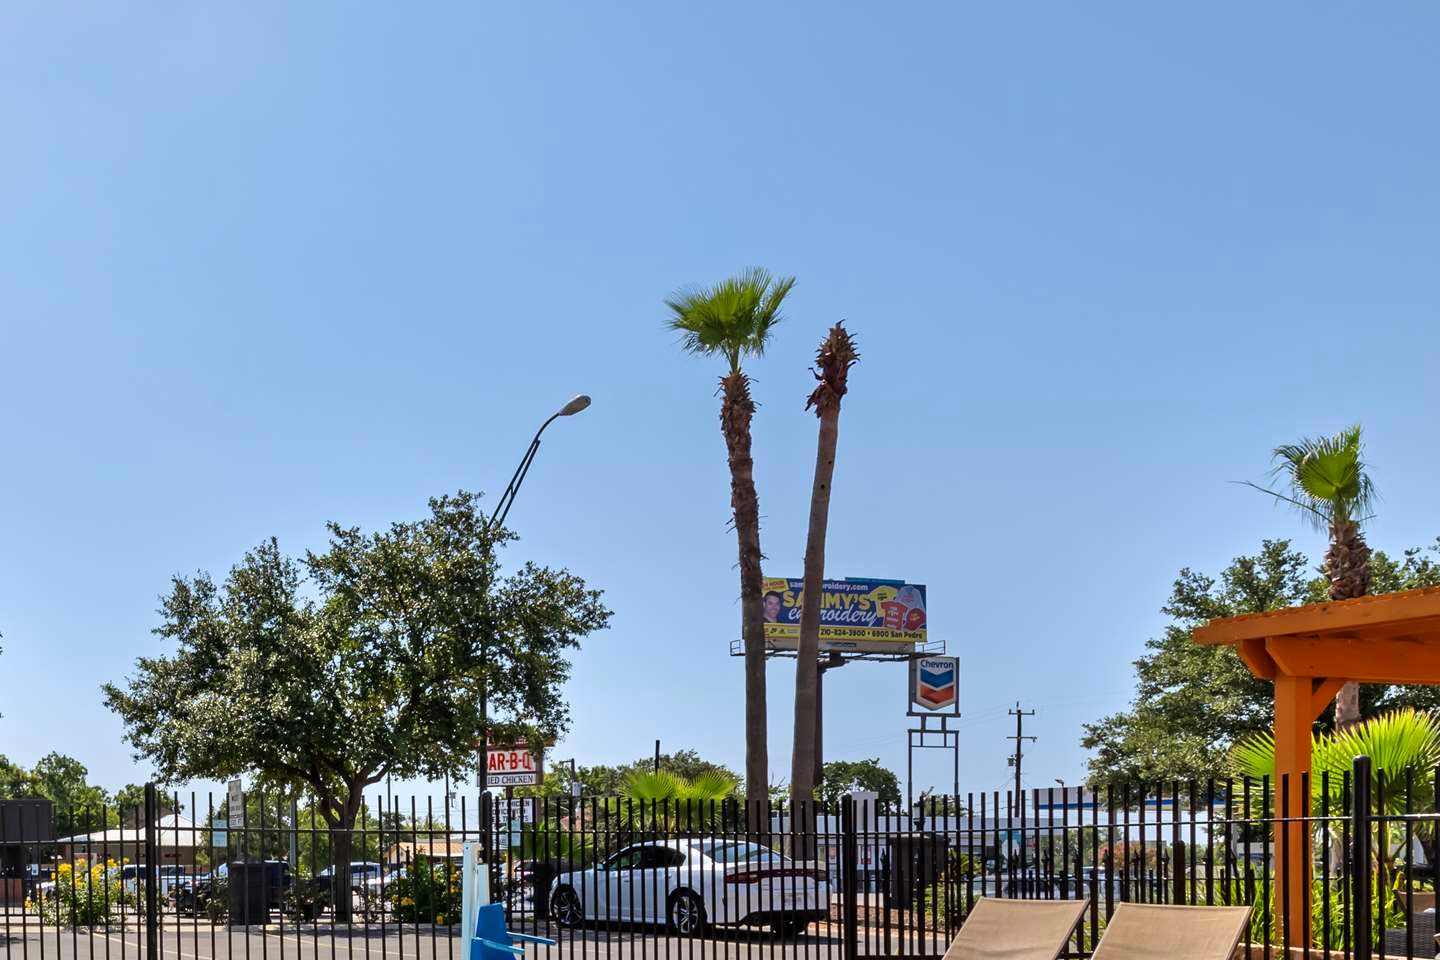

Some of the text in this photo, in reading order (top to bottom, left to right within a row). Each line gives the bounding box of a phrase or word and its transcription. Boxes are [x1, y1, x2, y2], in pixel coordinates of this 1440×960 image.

[783, 591, 871, 610] SAMY'S
[920, 659, 955, 669] Chevron
[488, 752, 531, 770] AR-B-Q
[501, 775, 533, 785] CHICKEN
